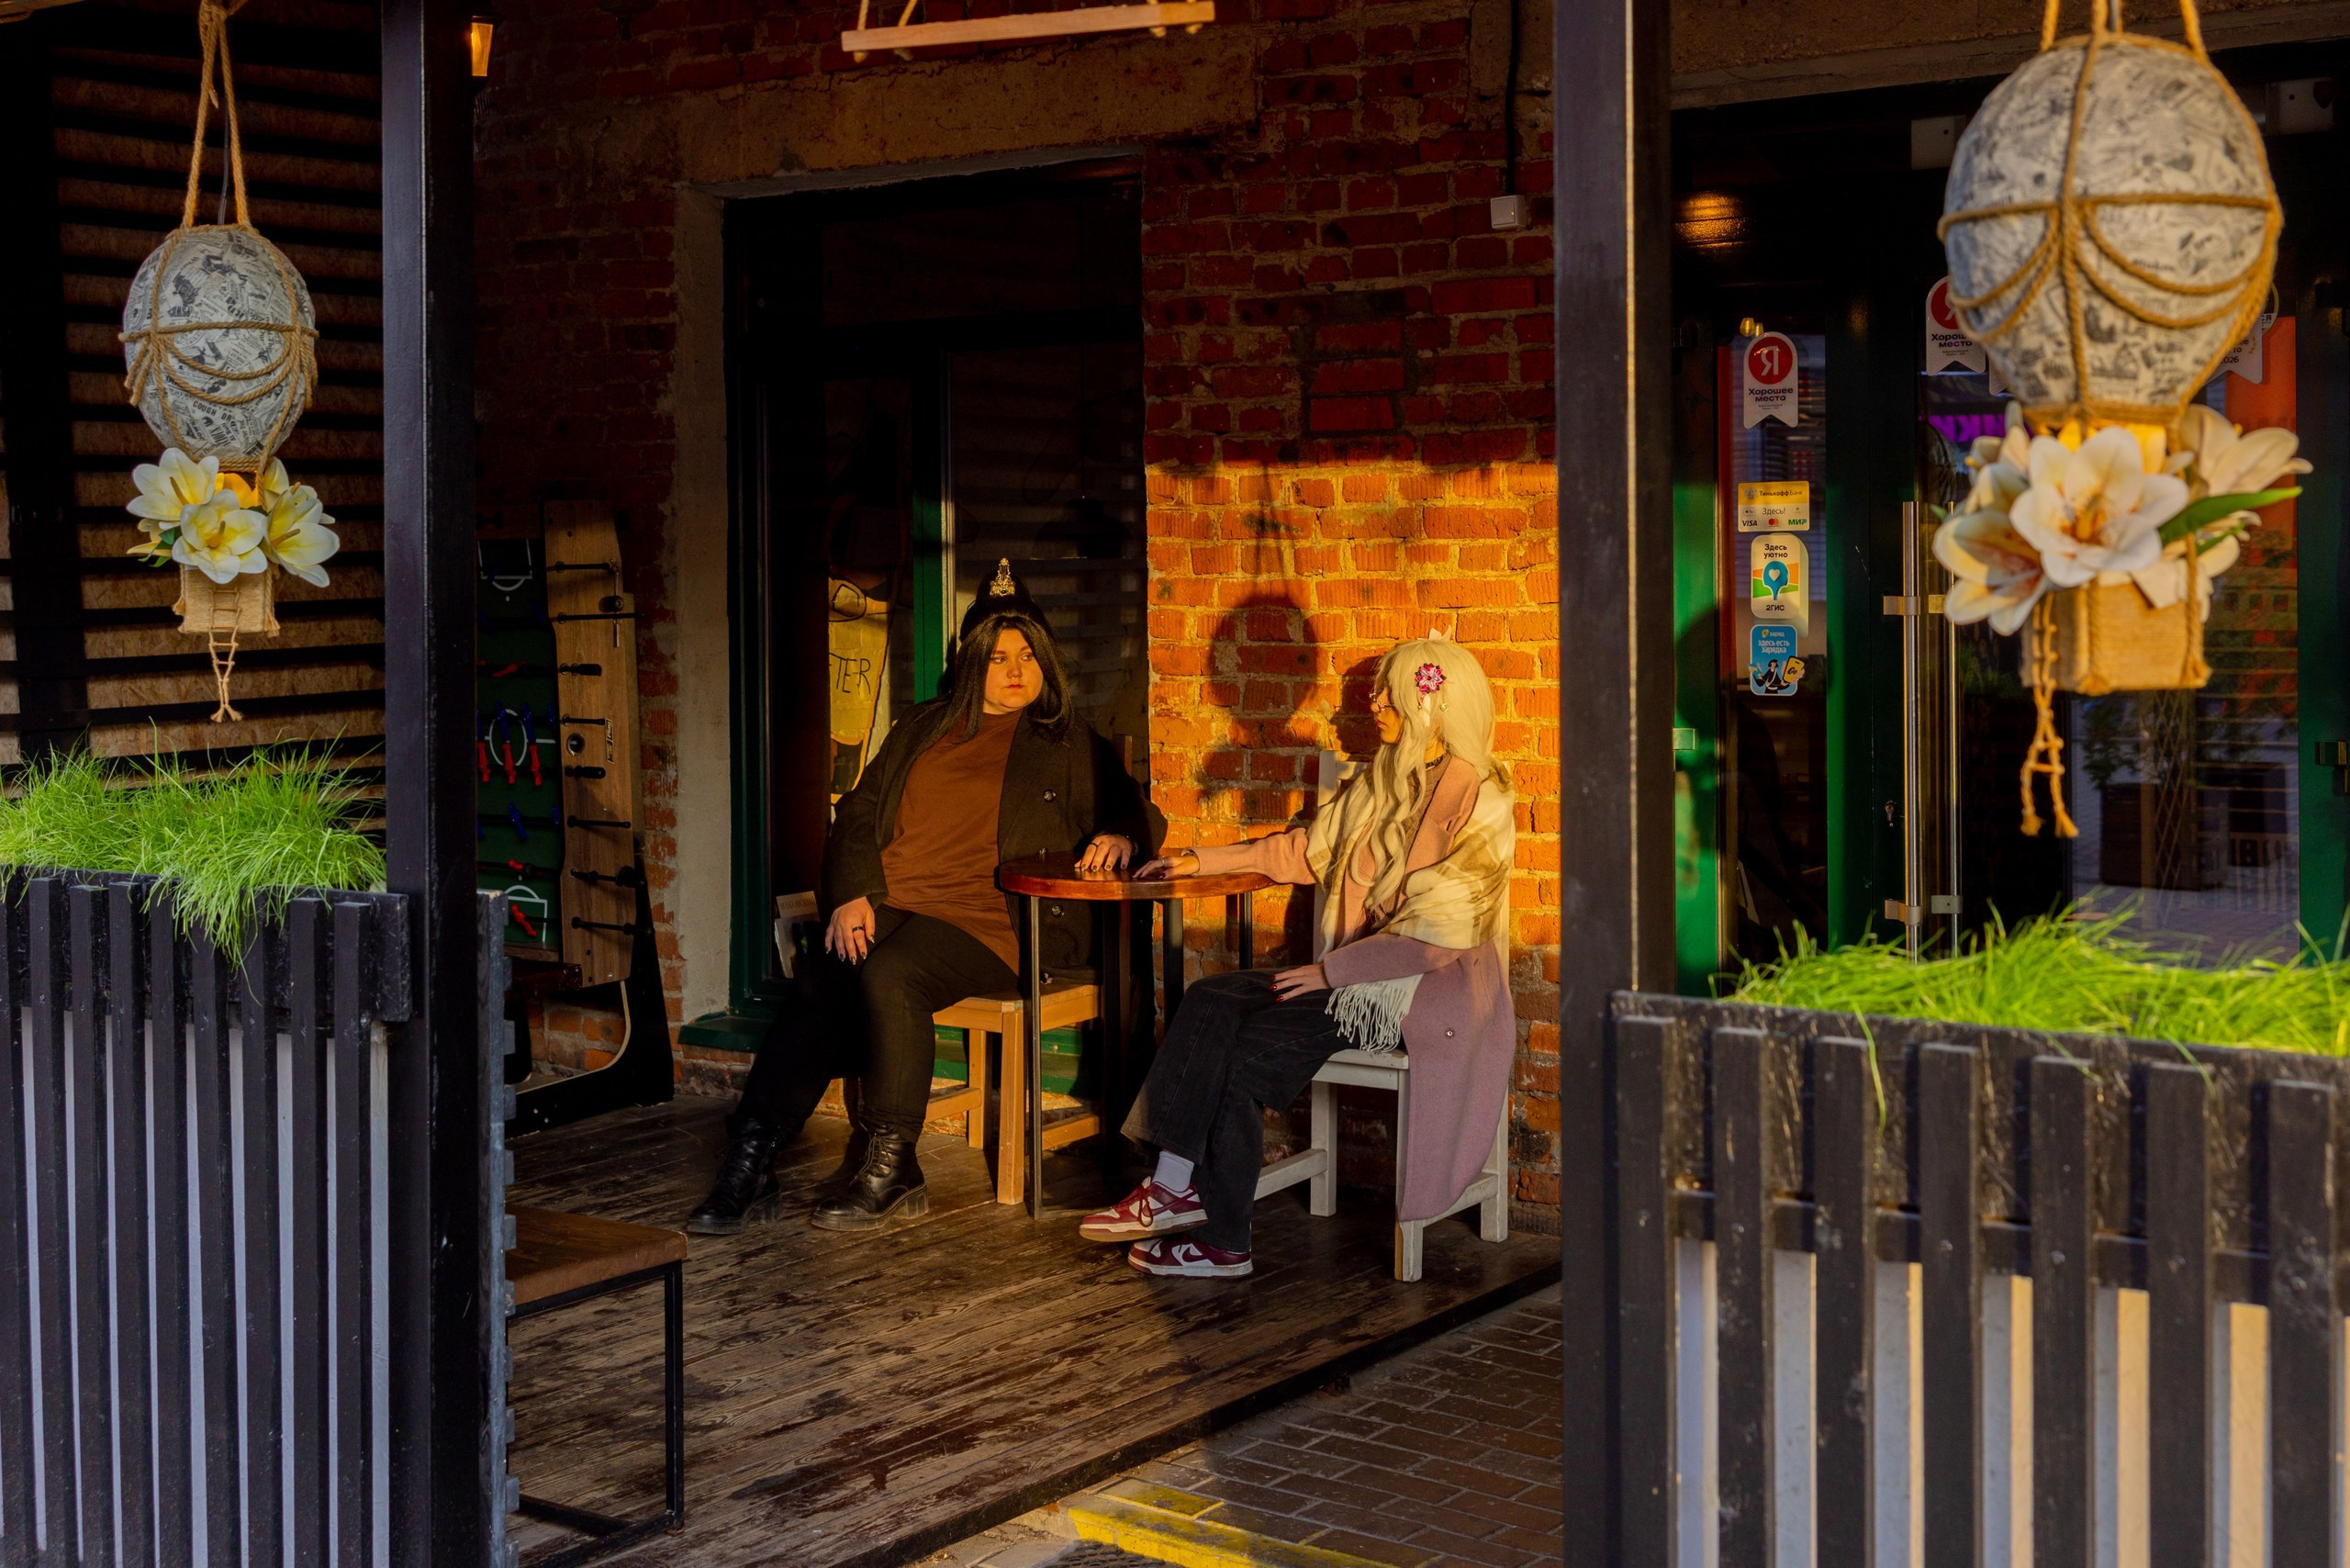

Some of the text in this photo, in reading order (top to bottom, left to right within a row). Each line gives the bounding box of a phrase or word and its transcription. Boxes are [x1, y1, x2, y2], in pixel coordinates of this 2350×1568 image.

[1931, 333, 1967, 342] Хорош
[1761, 345, 1779, 375] Я
[2221, 356, 2240, 364] 026
[1748, 387, 1794, 396] Хорошее
[193, 400, 218, 417] COUGH
[829, 652, 871, 695] TER
[1787, 666, 1797, 675] Go
